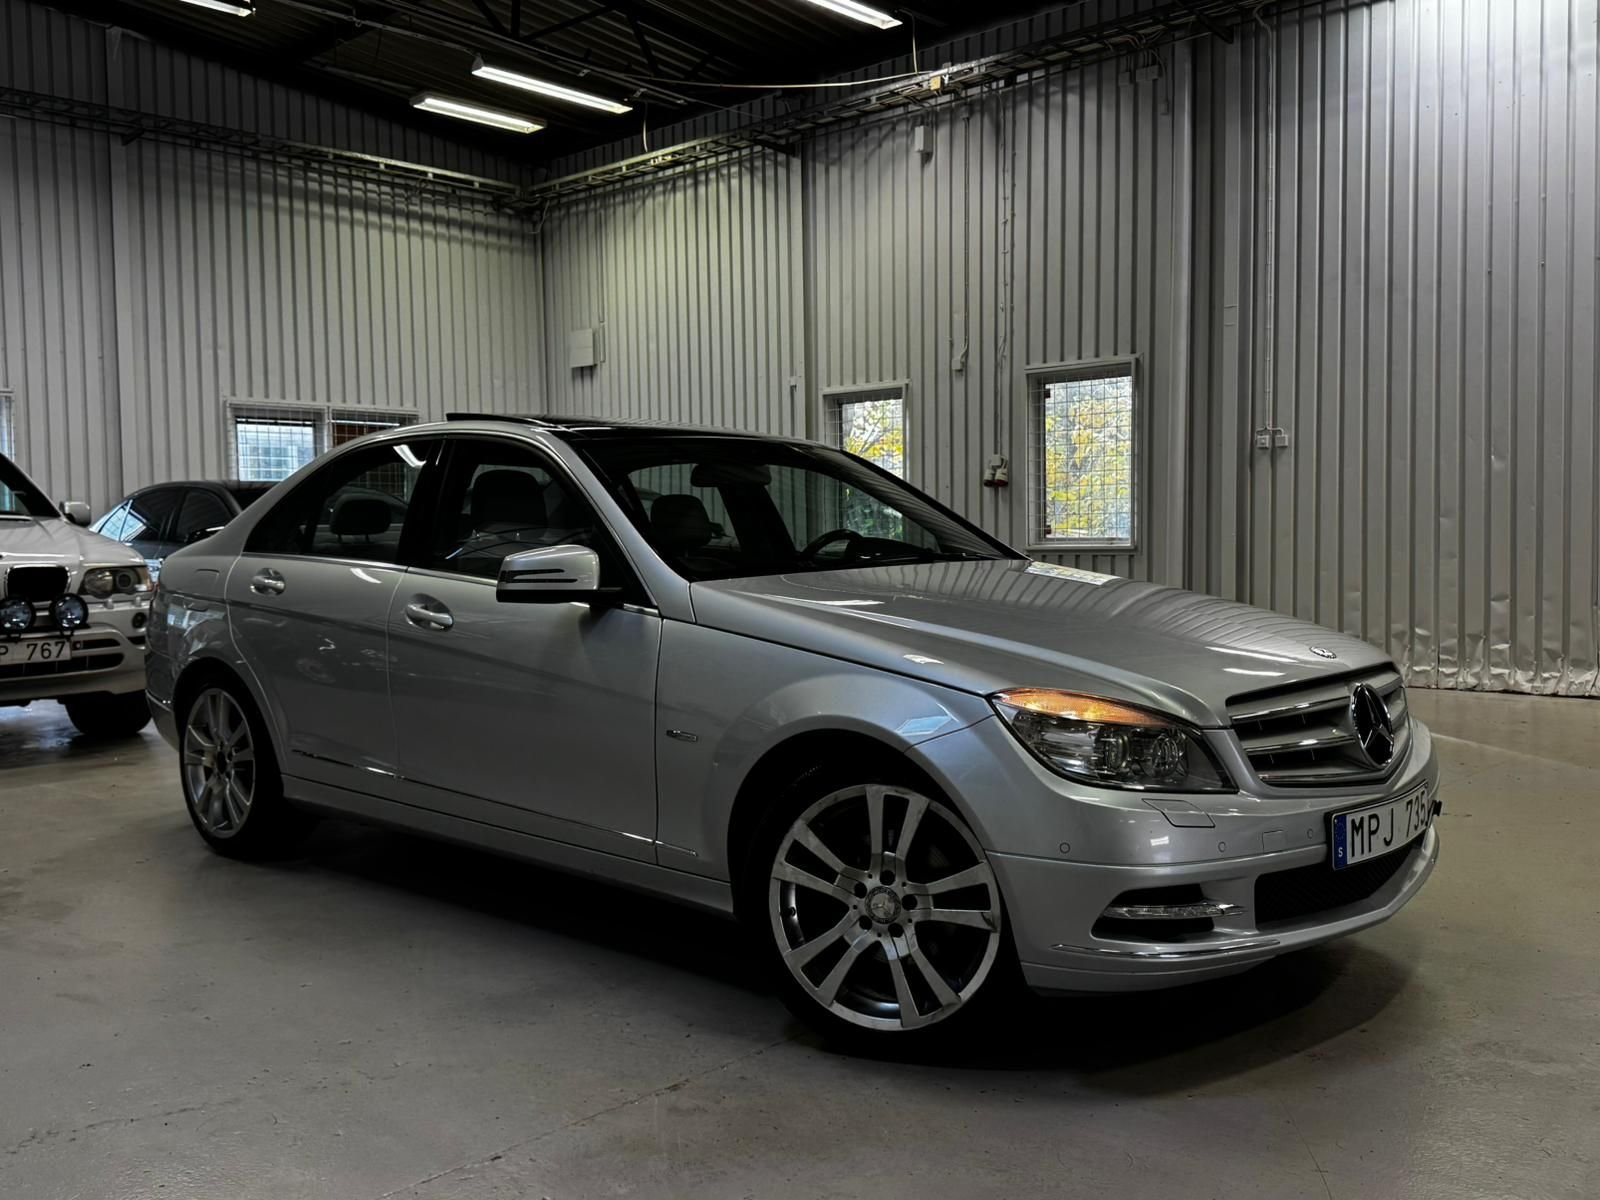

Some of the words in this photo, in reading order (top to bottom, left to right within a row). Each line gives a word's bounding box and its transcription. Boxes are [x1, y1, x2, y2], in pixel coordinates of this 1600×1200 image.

[26, 641, 66, 661] 767
[1350, 808, 1395, 857] MPJ
[1406, 790, 1426, 838] 735
[1338, 847, 1344, 858] S
